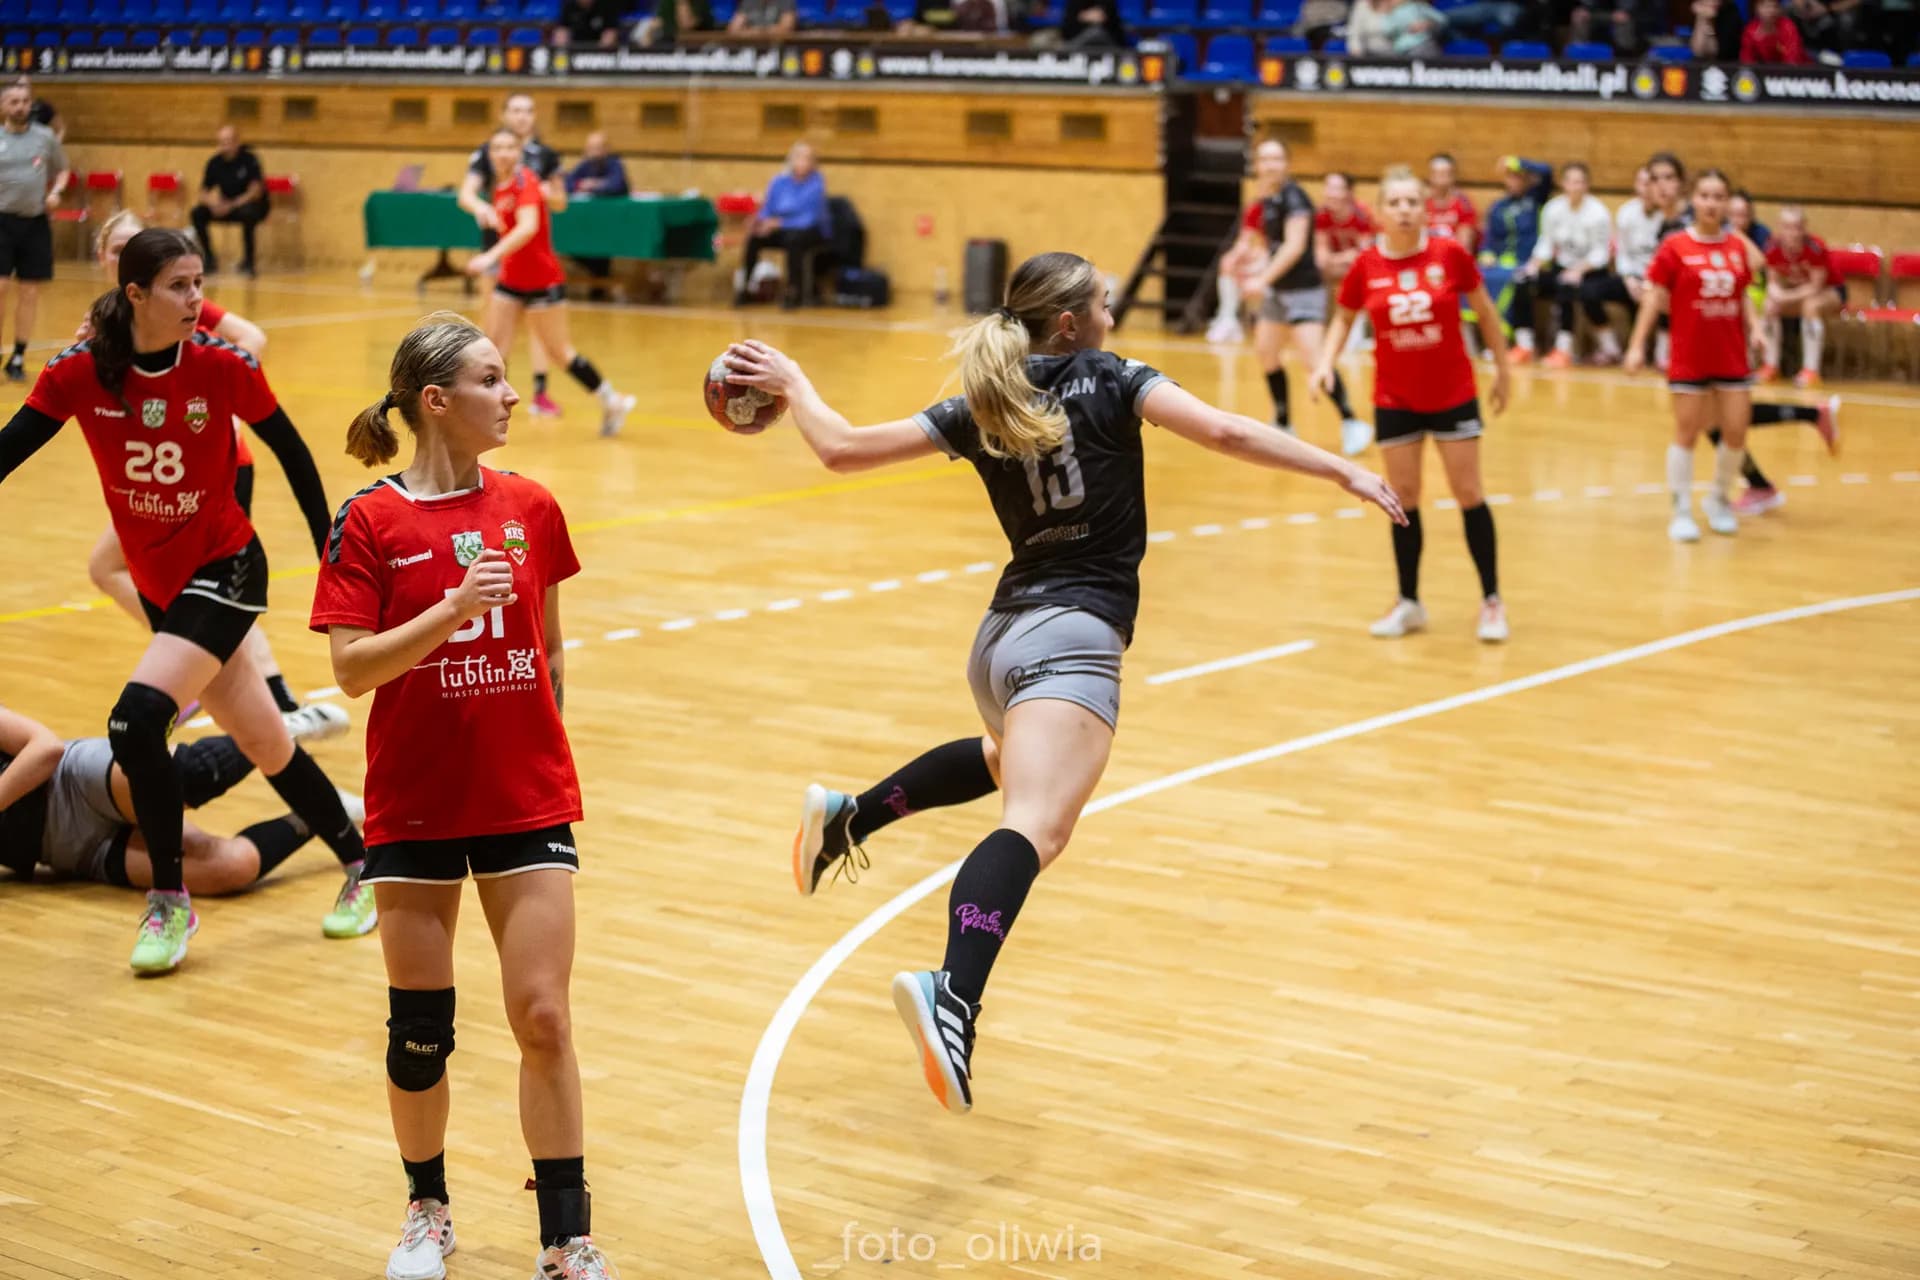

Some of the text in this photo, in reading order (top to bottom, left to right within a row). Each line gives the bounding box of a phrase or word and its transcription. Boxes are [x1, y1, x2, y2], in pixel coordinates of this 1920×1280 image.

[1350, 60, 1627, 99] www.koronahandball.pl
[1387, 291, 1434, 326] 22
[125, 440, 185, 485] 28
[396, 549, 432, 567] hummel
[441, 682, 537, 699] MIASTO INSPIRACJI
[405, 1040, 439, 1053] SELECT
